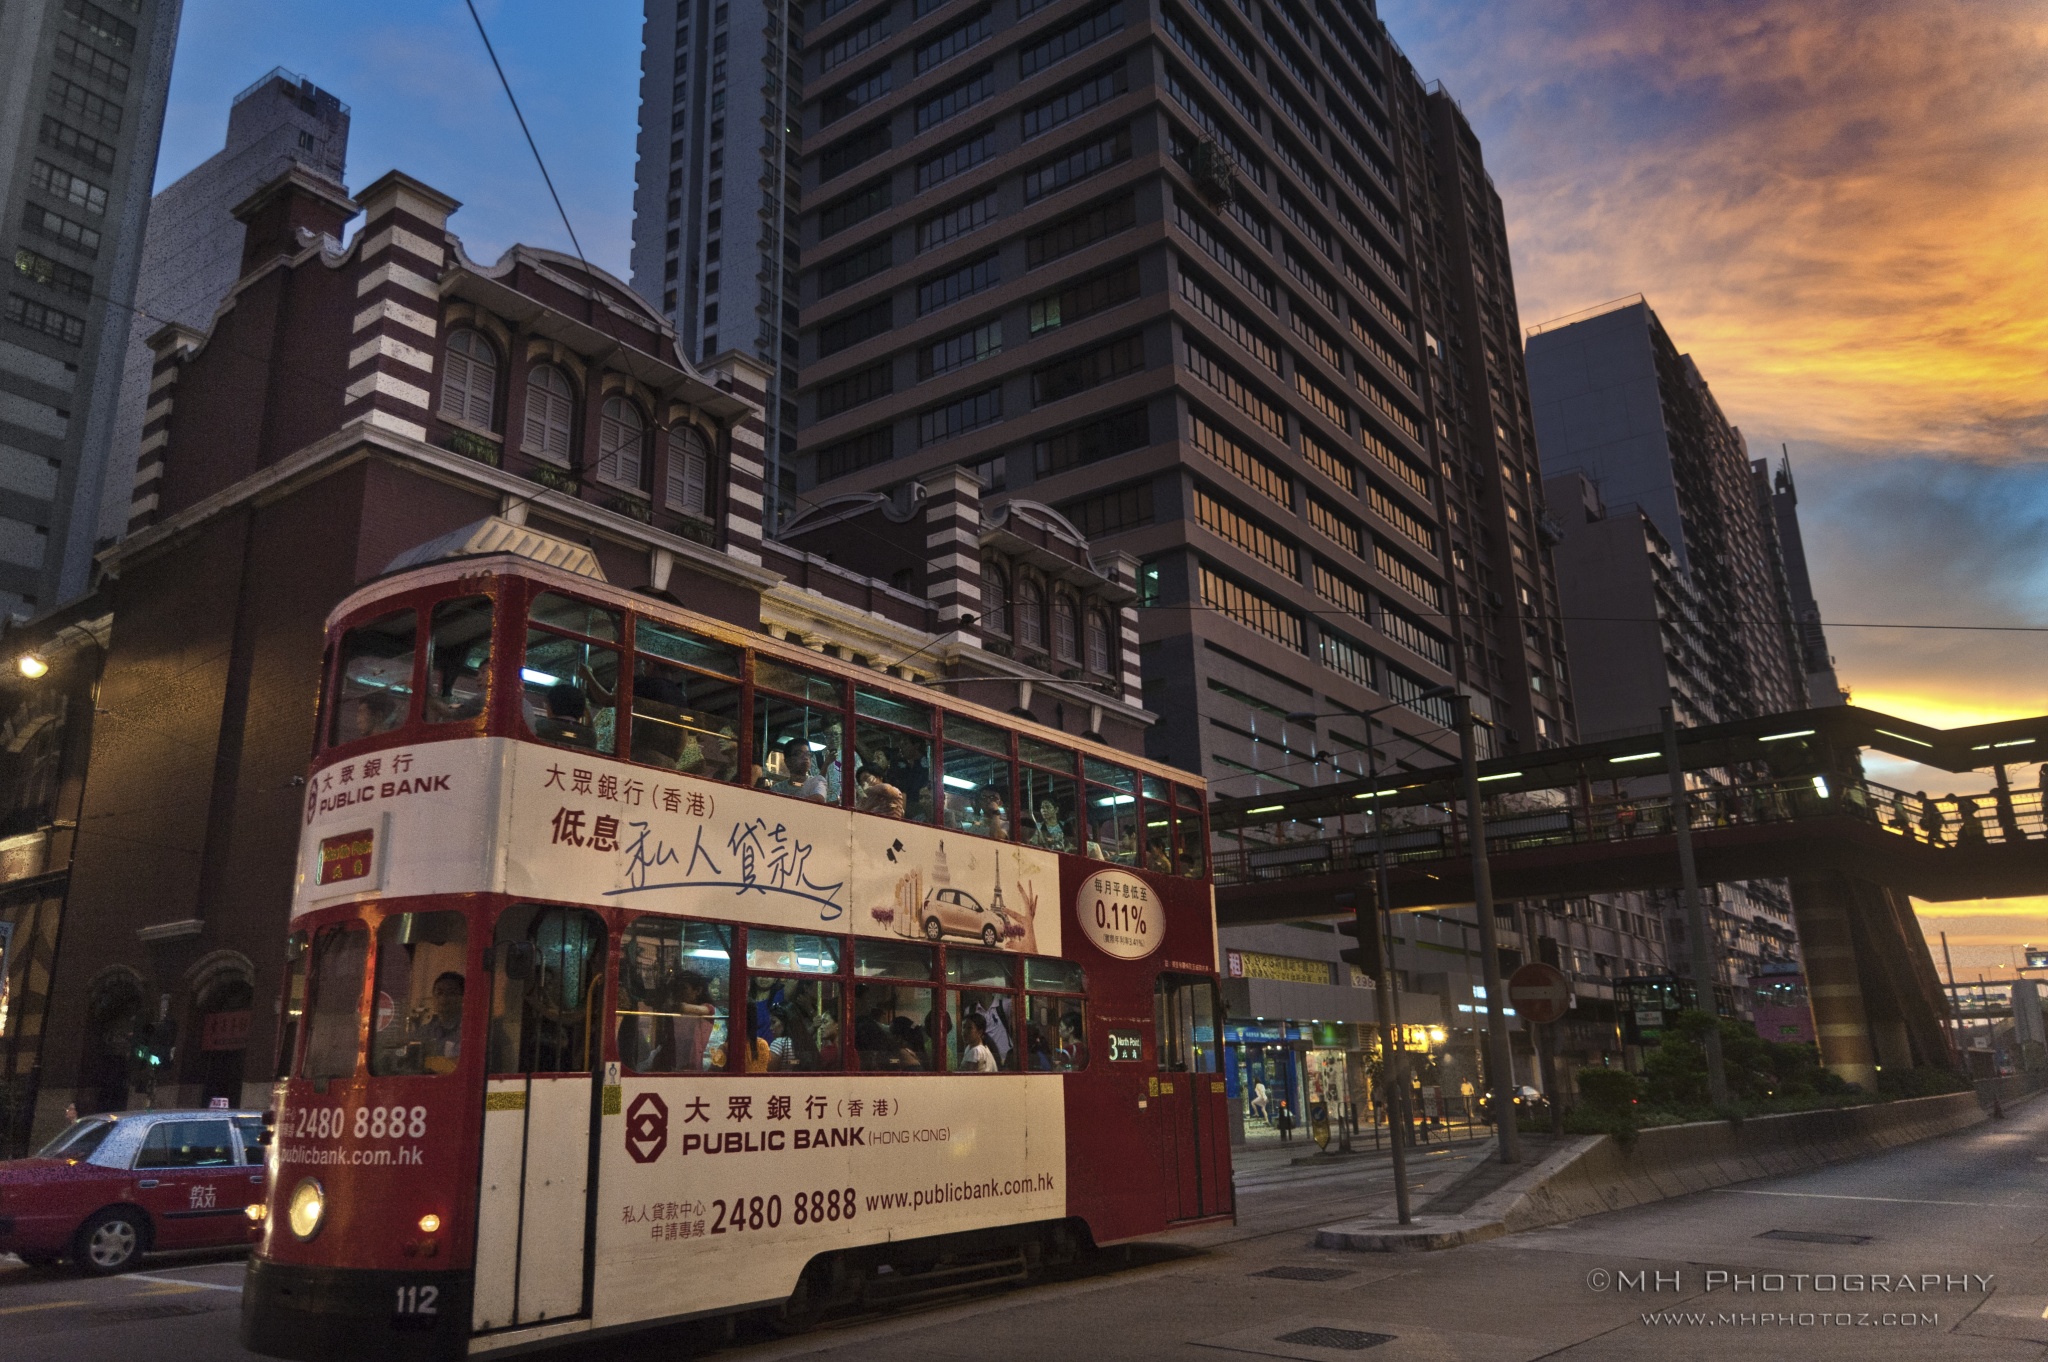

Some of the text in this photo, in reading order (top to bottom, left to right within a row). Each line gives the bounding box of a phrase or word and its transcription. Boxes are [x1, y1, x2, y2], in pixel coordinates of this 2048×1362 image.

[322, 753, 414, 793] 大眾銀行
[319, 774, 452, 816] PUBLIC BANK
[544, 762, 715, 820] 大眾銀行(香港)
[551, 806, 620, 852] 低息
[1094, 877, 1148, 902] 每月平息低至
[1095, 899, 1147, 935] 0.11%
[1108, 1034, 1119, 1061] 3
[296, 1107, 345, 1139] 2480
[353, 1105, 428, 1139] 8888
[682, 1126, 951, 1156] PUBLIC BANK (HONG KONG)
[189, 1195, 217, 1209] TAXI
[191, 1184, 217, 1197] 的士
[710, 1172, 1054, 1235] 2480 8888 www.publicbank.com.hk
[621, 1199, 707, 1225] 私人貸款中心
[650, 1219, 706, 1242] 申請專線
[397, 1285, 439, 1314] 112
